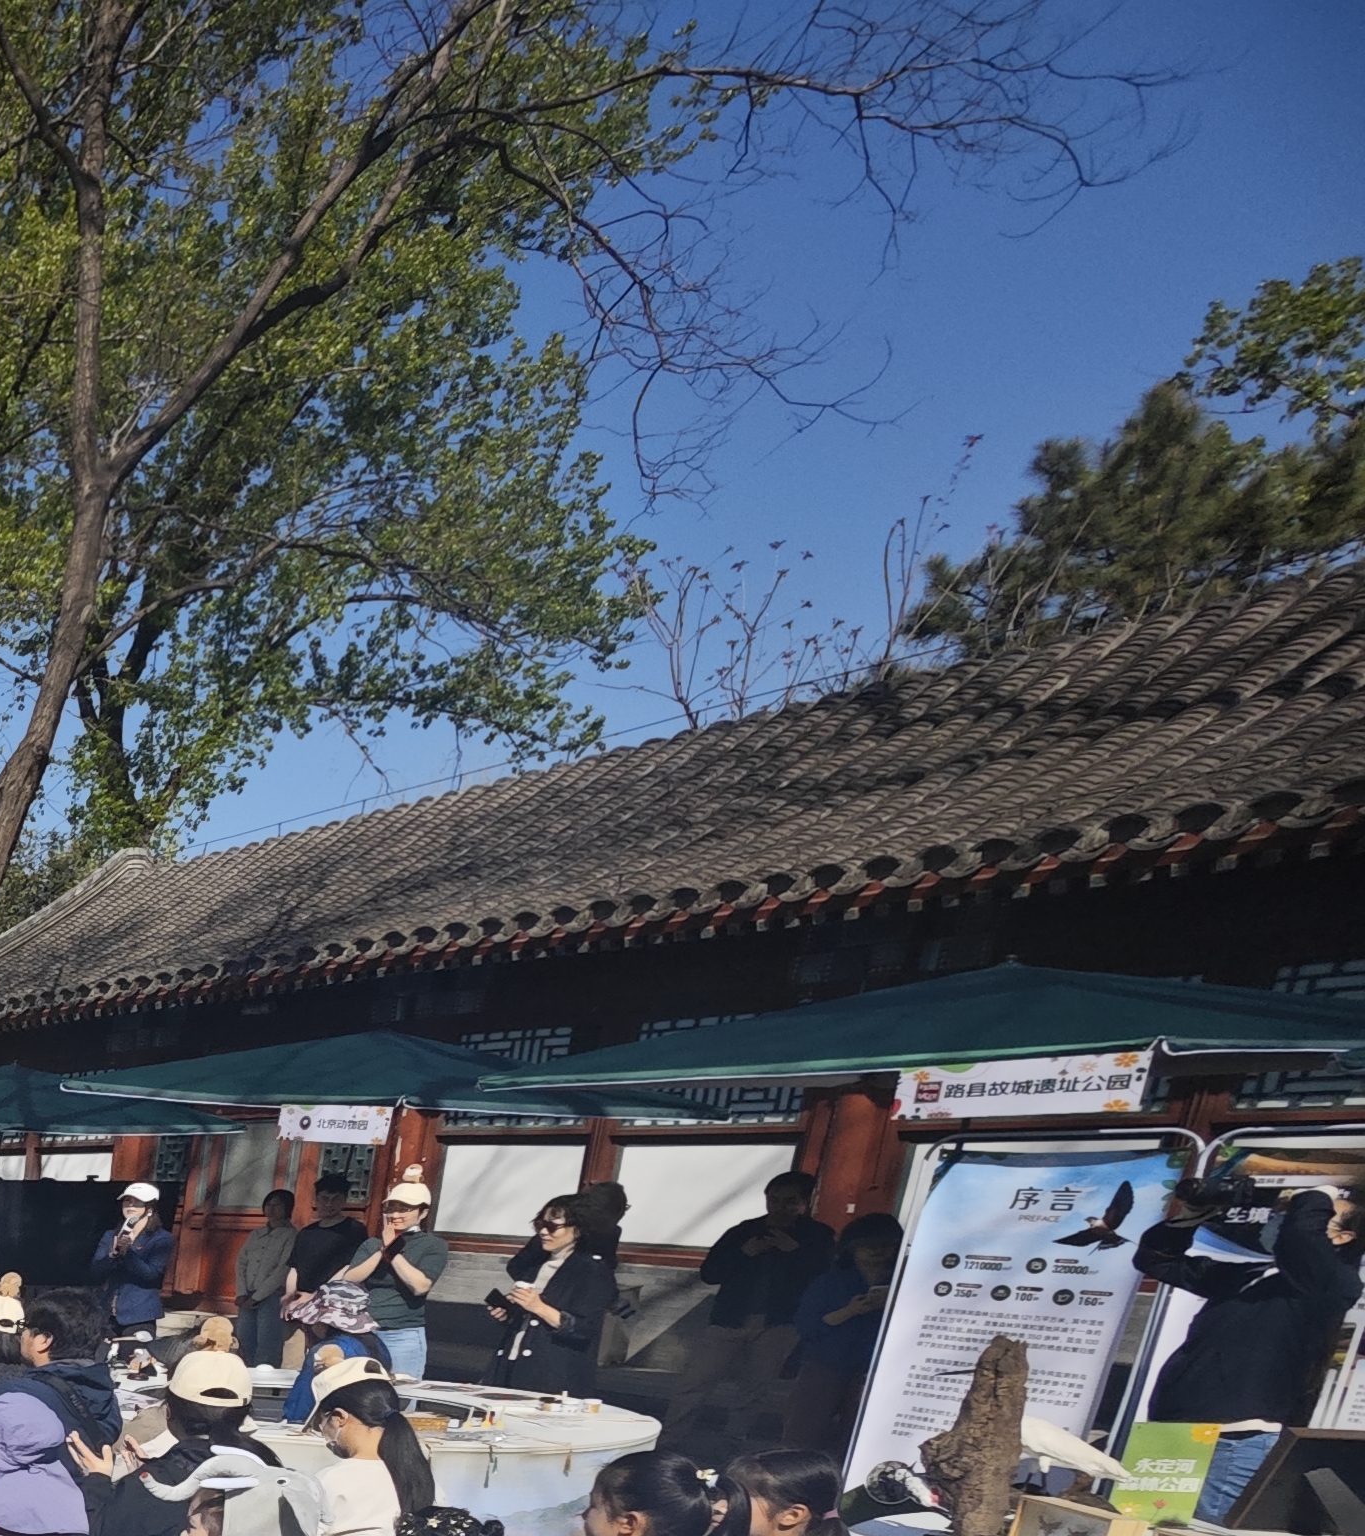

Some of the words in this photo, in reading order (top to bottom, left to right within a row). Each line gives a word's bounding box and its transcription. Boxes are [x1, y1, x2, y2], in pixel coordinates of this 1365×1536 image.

[943, 1073, 1133, 1099] 路县故城遗址公园
[316, 1118, 369, 1131] 北京动物园
[1009, 1187, 1082, 1212] 序言
[1018, 1215, 1061, 1223] PREFACE
[1133, 1458, 1198, 1474] 永定河
[1117, 1476, 1201, 1492] 森林公园
